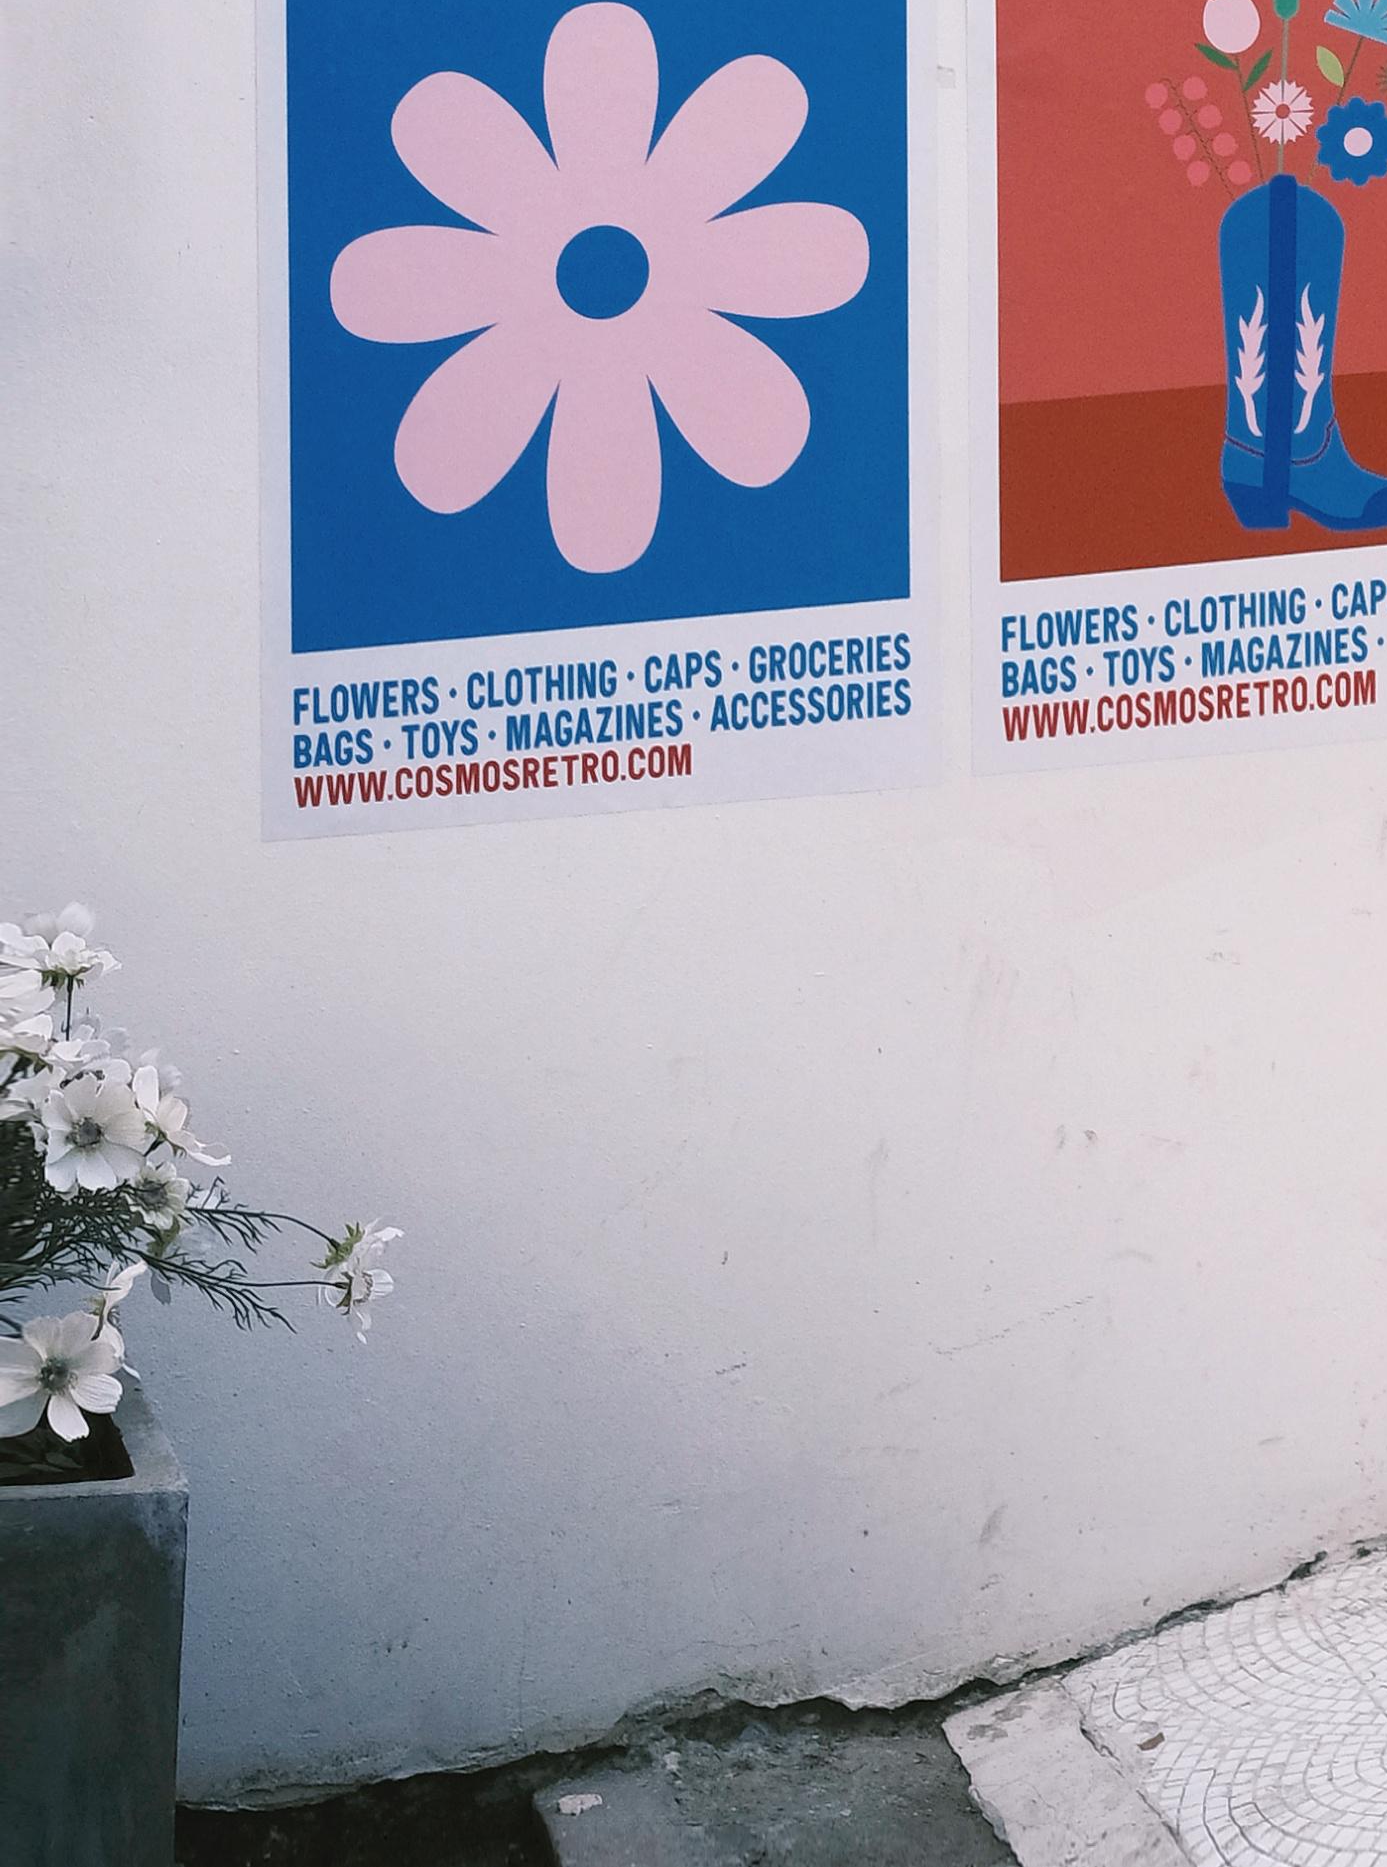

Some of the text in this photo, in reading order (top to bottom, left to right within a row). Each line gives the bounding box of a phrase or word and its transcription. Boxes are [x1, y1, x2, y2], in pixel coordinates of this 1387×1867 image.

[1001, 604, 1138, 651] FLOWERS
[1164, 587, 1306, 637] CLOTHING
[292, 634, 911, 725] FLOWERS CLOTHING CAPS GROCERIES
[1002, 654, 1077, 698] BAGS
[1104, 645, 1175, 686] TOYS
[1201, 625, 1368, 677] MAGAZINES
[293, 678, 912, 769] BAGS TOYS MAGAZINES ACCESSORIES
[1003, 669, 1376, 741] WWW.COSMOSRETRO.COM
[295, 744, 691, 806] WWW.COSMOSRETRO.COM
